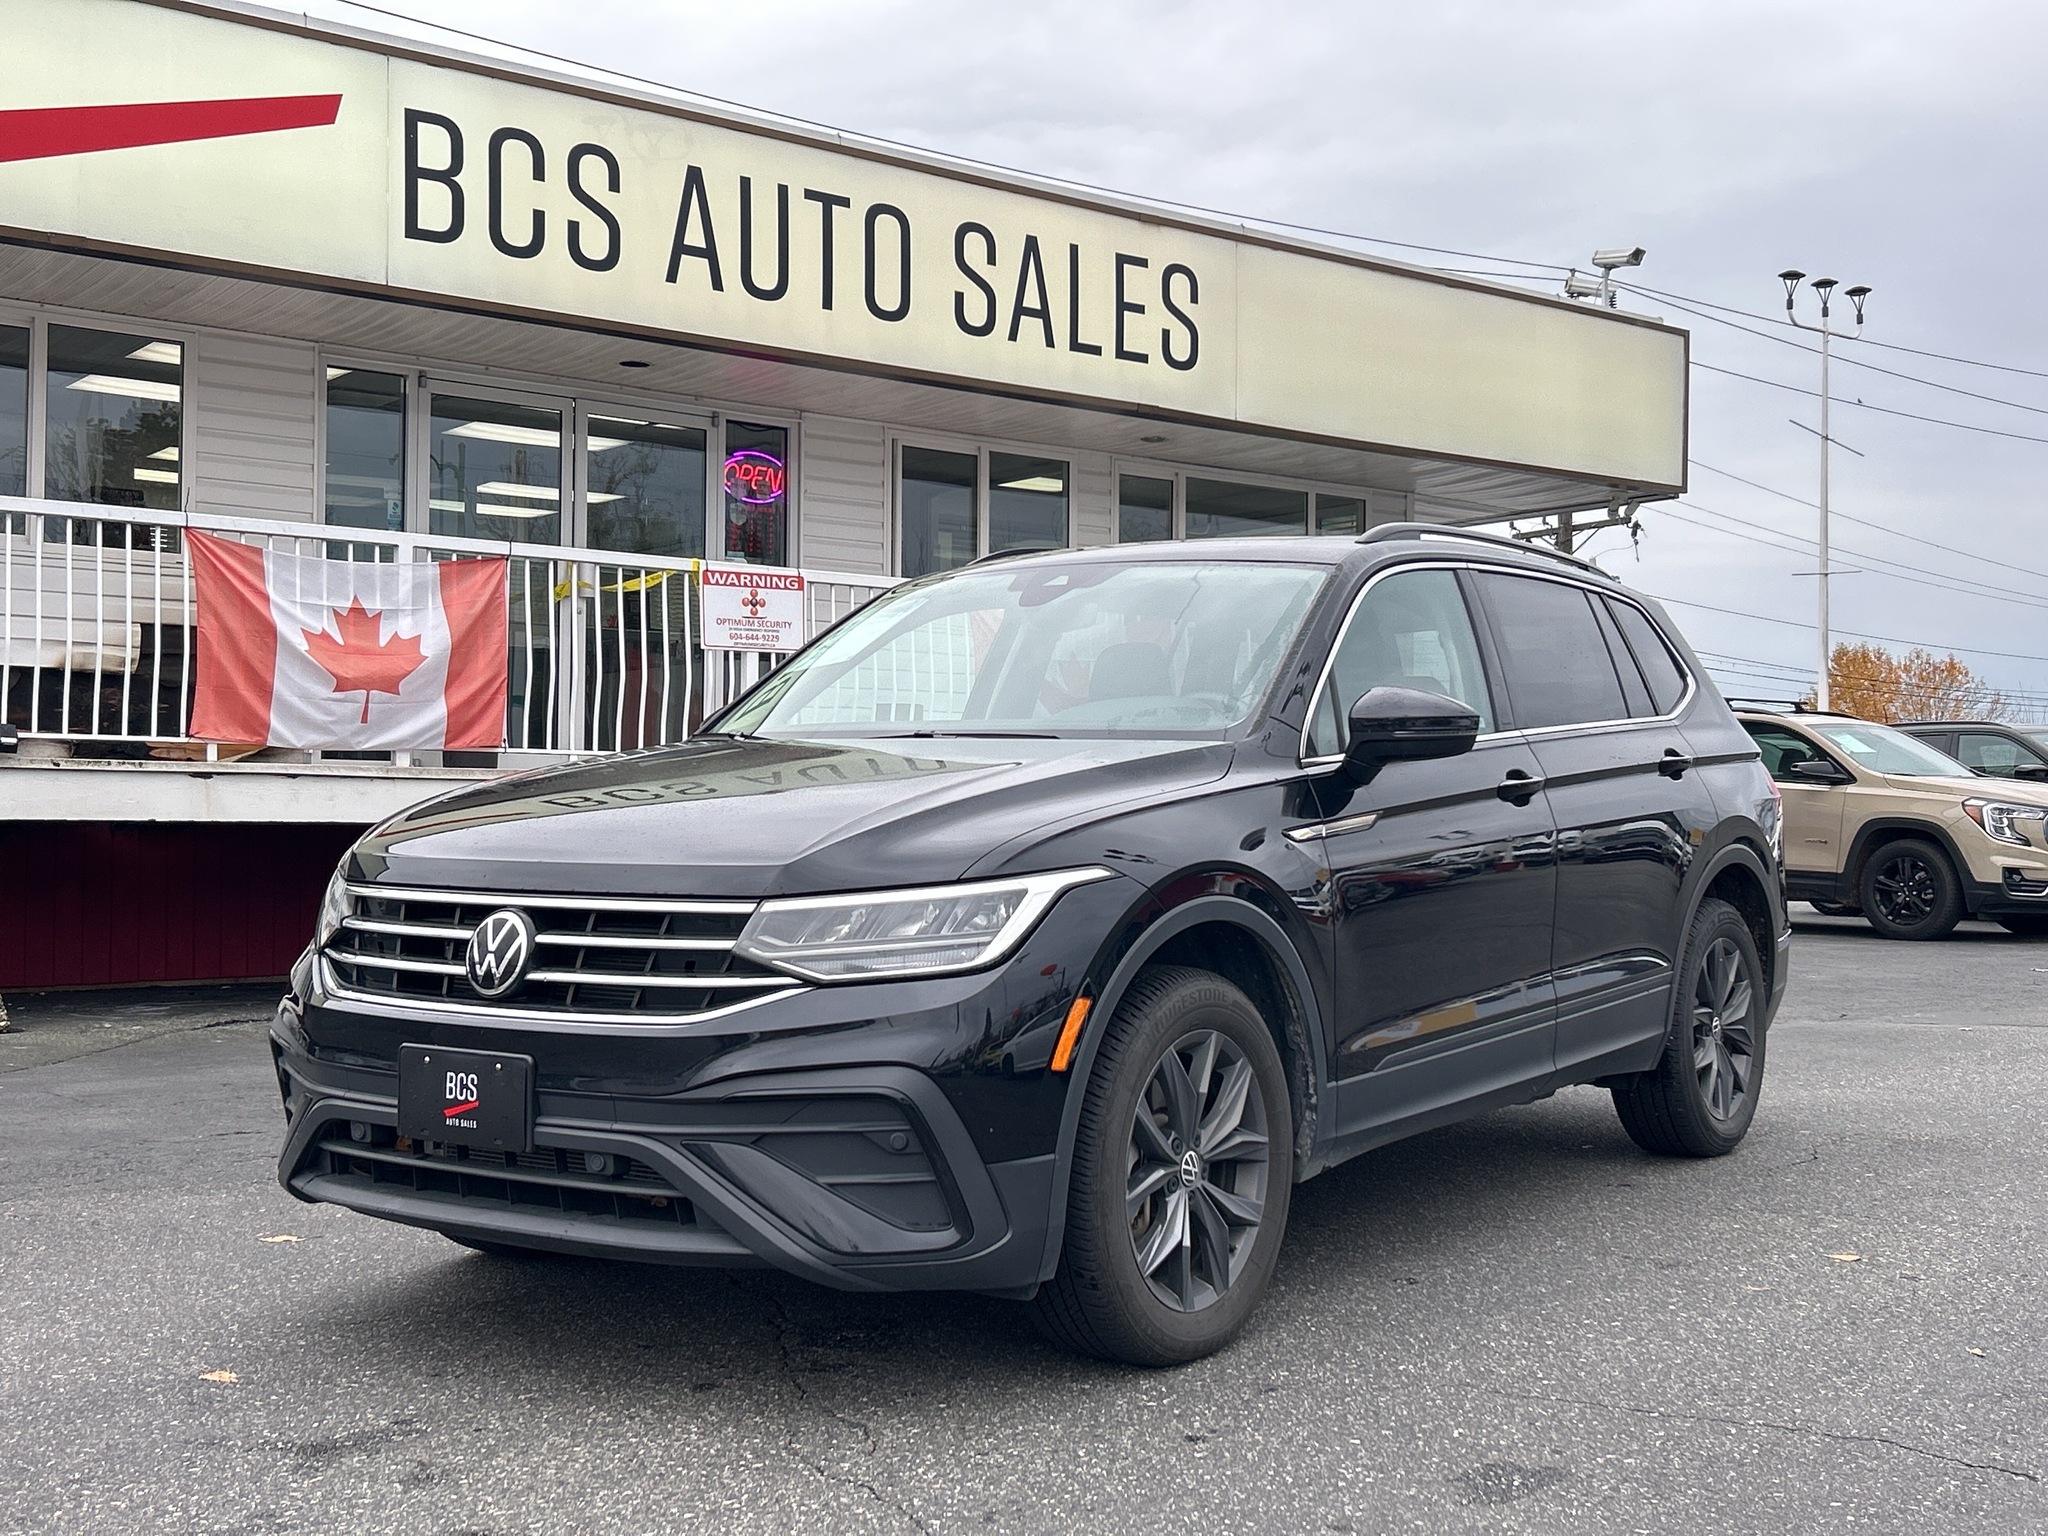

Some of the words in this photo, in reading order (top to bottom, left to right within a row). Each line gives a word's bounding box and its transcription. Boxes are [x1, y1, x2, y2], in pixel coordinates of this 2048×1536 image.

[404, 107, 621, 272] BCS
[665, 164, 912, 322] AUTO
[953, 221, 1200, 372] SALES
[724, 462, 782, 492] OPEN
[707, 572, 799, 589] WARNING
[716, 617, 755, 627] OPTIMUM
[757, 620, 792, 630] SECURITY
[729, 632, 780, 643] 604-644-9229
[467, 910, 528, 995] VW
[446, 1071, 478, 1101] BCS
[446, 1118, 459, 1128] AUTO
[460, 1119, 477, 1129] SALES
